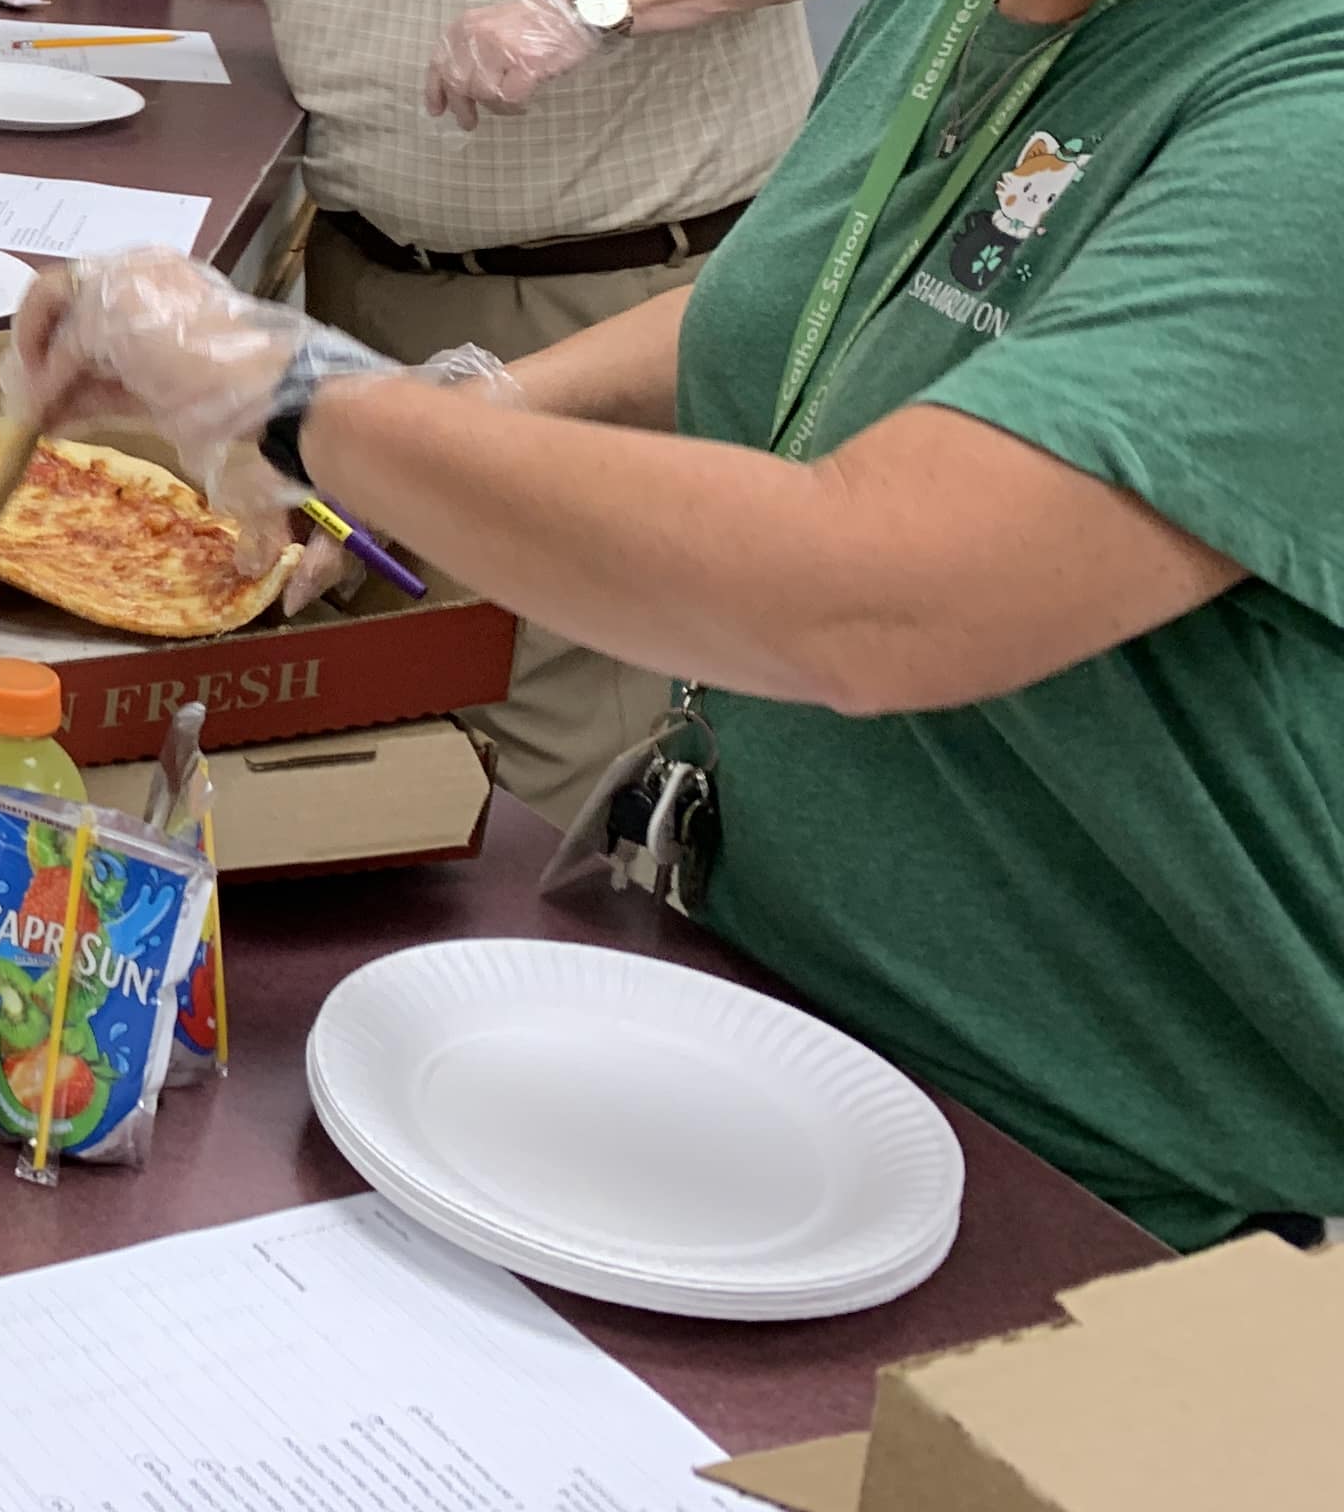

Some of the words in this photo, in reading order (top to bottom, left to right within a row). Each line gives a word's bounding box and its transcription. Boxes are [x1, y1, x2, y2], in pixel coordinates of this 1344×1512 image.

[782, 302, 833, 402] Catholic
[822, 211, 872, 295] School
[971, 300, 1012, 338] ON
[102, 656, 323, 730] FRESH
[77, 931, 155, 1006] SUN
